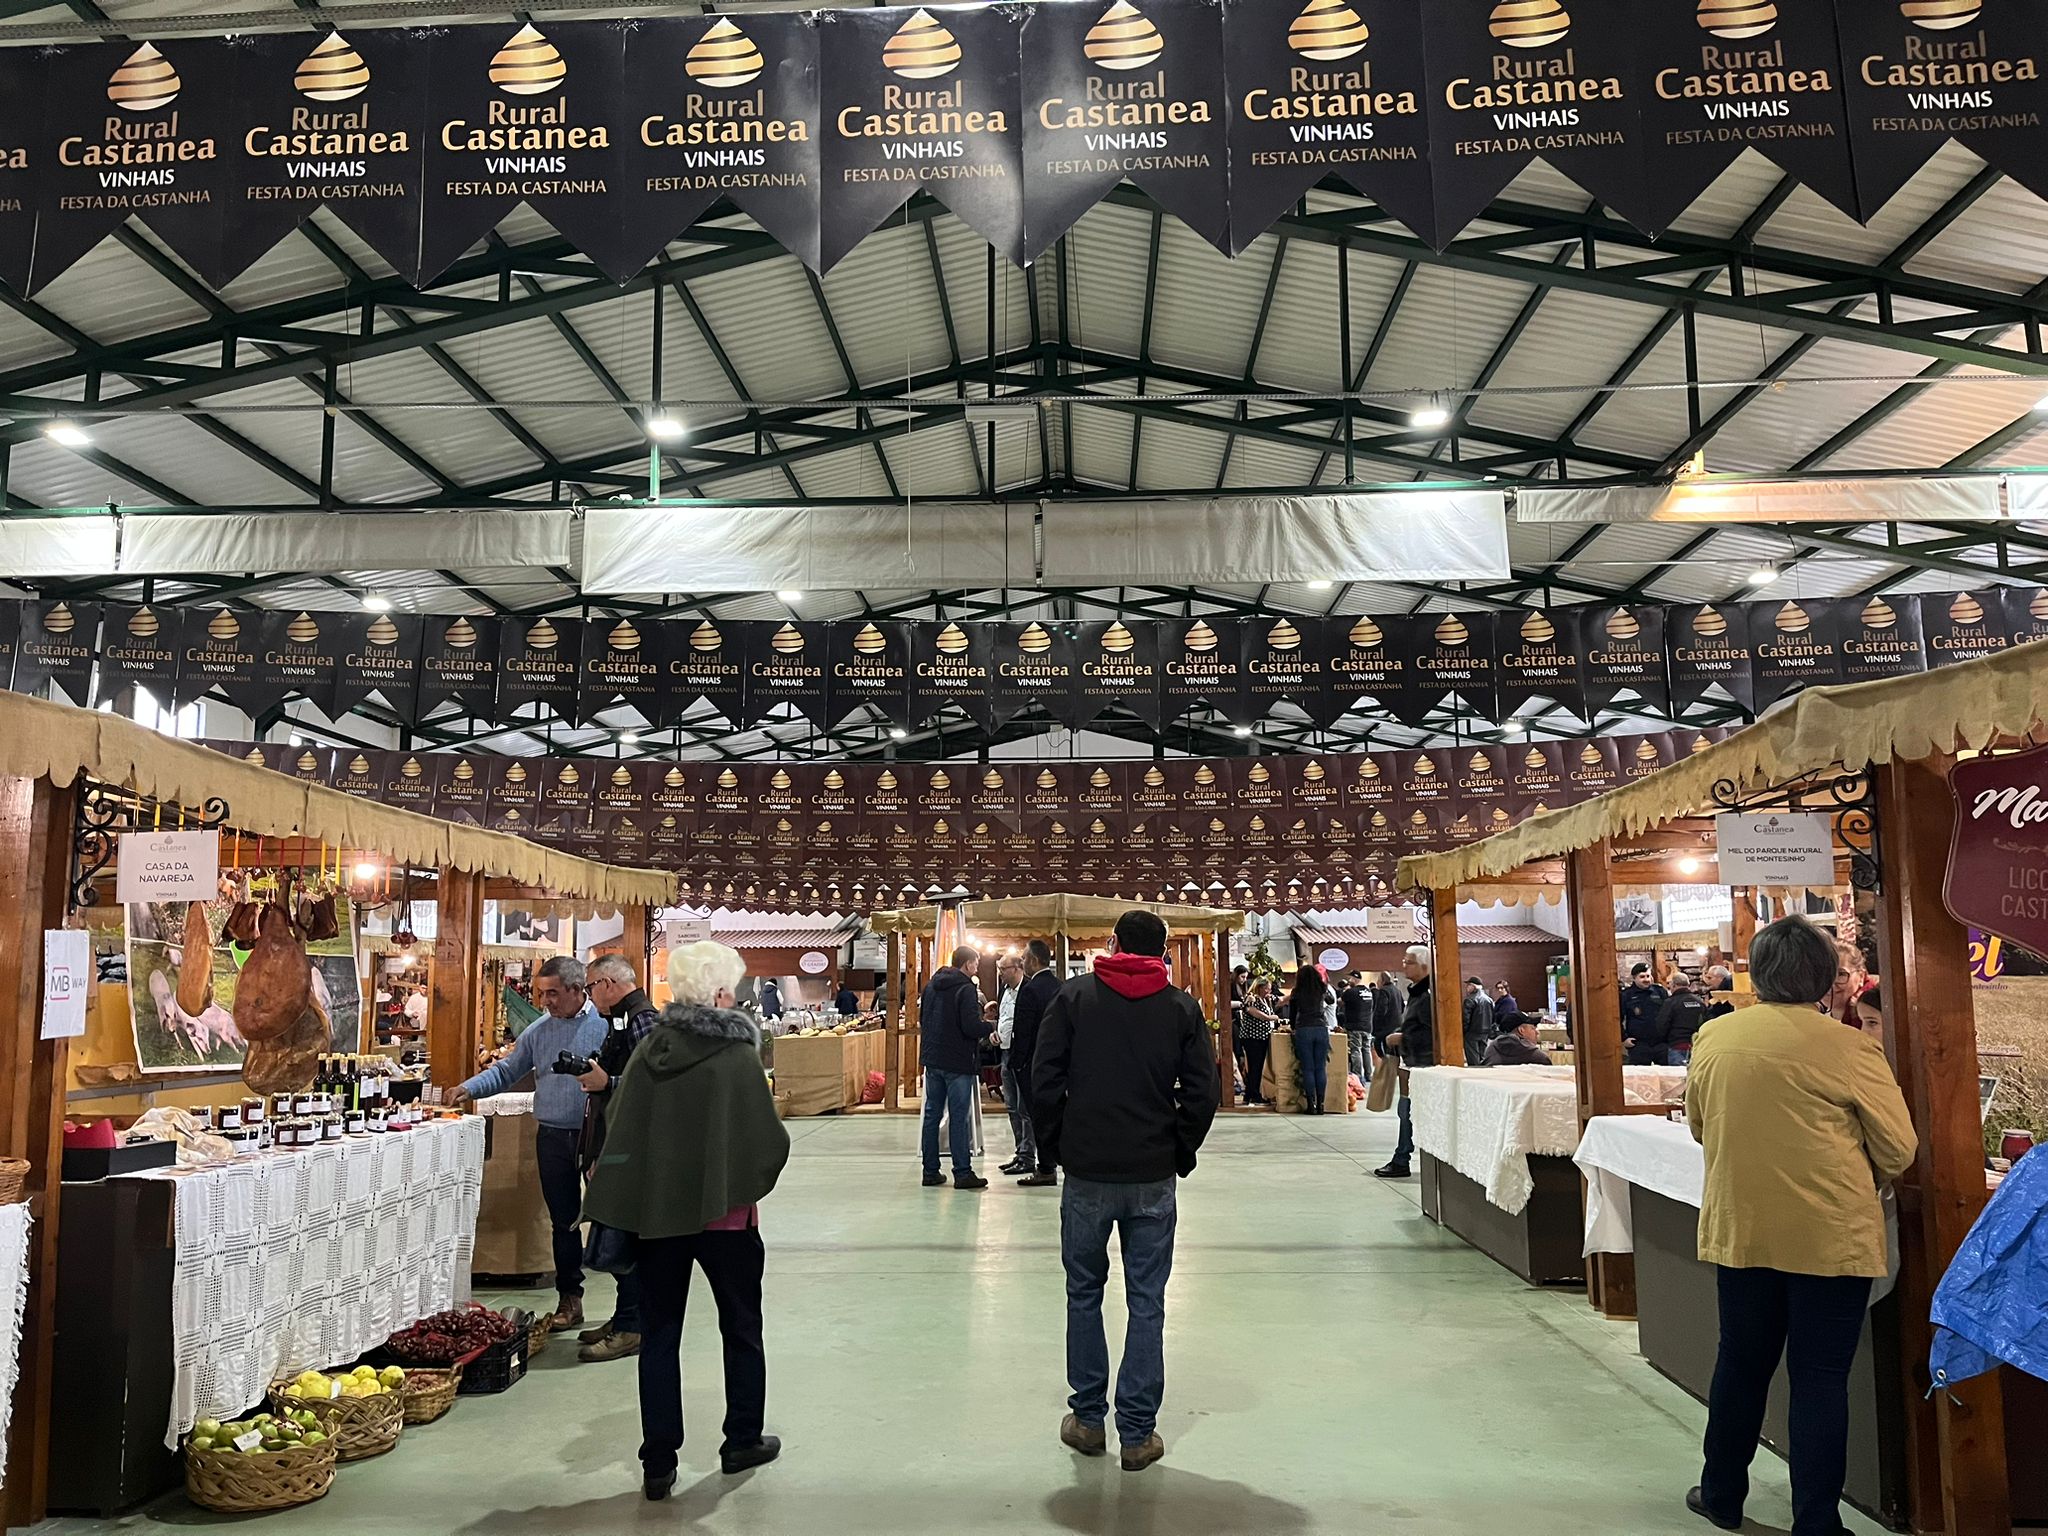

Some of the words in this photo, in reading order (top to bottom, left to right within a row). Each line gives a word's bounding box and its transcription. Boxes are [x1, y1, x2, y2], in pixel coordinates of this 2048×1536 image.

[1906, 31, 1985, 60] Rural
[1703, 40, 1782, 69] Rural
[1493, 49, 1574, 80] Rural
[1862, 56, 2038, 85] Castanea
[1291, 62, 1370, 91] Rural
[1085, 71, 1165, 100] Rural
[1656, 69, 1832, 99] Castanea
[885, 80, 962, 109] Rural
[1446, 78, 1623, 109] Castanea
[1908, 91, 1992, 109] VINHAIS
[489, 97, 565, 124] Rural
[687, 89, 763, 118] Rural
[1244, 90, 1418, 120] Castanea
[1704, 100, 1789, 120] VINHAIS
[292, 103, 368, 130] Rural
[1039, 99, 1211, 129] Castanea
[1493, 109, 1579, 130] VINHAIS
[105, 111, 177, 140] Rural
[837, 106, 1008, 137] Castanea
[1873, 118, 1919, 130] FESTA
[1924, 116, 1947, 131] DA
[1948, 113, 2039, 130] CASTANHA
[442, 121, 609, 150] Castanea
[641, 115, 809, 147] Castanea
[1290, 123, 1373, 142] VINHAIS
[1667, 130, 1714, 144] FESTA
[1718, 128, 1742, 141] DA
[1746, 123, 1834, 139] CASTANHA
[246, 127, 409, 155] Castanea
[1084, 132, 1167, 151] VINHAIS
[1456, 140, 1503, 155] FESTA
[1507, 138, 1531, 151] DA
[1535, 132, 1624, 149] CASTANHA
[59, 137, 216, 165] Castanea
[882, 141, 963, 159] VINHAIS
[1252, 151, 1298, 165] FESTA
[1303, 150, 1325, 163] DA
[1329, 147, 1416, 162] CASTANHA
[485, 157, 566, 173] VINHAIS
[684, 149, 765, 168] VINHAIS
[1047, 160, 1092, 174] FESTA
[1096, 158, 1119, 172] DA
[1123, 155, 1209, 170] CASTANHA
[287, 161, 365, 178] VINHAIS
[845, 168, 890, 182] FESTA
[894, 168, 916, 180] DA
[919, 164, 1005, 181] CASTANHA
[99, 169, 174, 187] VINHAIS
[647, 177, 691, 191] FESTA
[695, 176, 717, 188] DA
[721, 173, 807, 187] CASTANHA
[248, 187, 291, 199] FESTA
[296, 186, 317, 198] DA
[322, 184, 404, 198] CASTANHA
[447, 182, 492, 195] FESTA
[496, 182, 518, 194] DA
[522, 180, 606, 194] CASTANHA
[61, 196, 103, 209] FESTA
[107, 193, 129, 209] DA
[132, 190, 210, 207] CASTANHA
[24, 641, 88, 656] Castanea
[1844, 640, 1919, 653] Castanea
[1933, 636, 2006, 649] Castanea
[107, 645, 172, 660] Castanea
[187, 648, 253, 663] Castanea
[1589, 650, 1660, 663] Castanea
[1676, 648, 1749, 661] Castanea
[1758, 644, 1833, 657] Castanea
[39, 657, 69, 665] VINHAIS
[122, 661, 154, 669] VINHAIS
[266, 651, 333, 666] Castanea
[346, 654, 412, 669] Castanea
[425, 657, 492, 671] Castanea
[507, 658, 573, 672] Castanea
[1331, 658, 1402, 671] Castanea
[1417, 656, 1488, 669] Castanea
[1503, 654, 1576, 667] Castanea
[1778, 658, 1815, 666] VINHAIS
[1864, 654, 1901, 663] VINHAIS
[203, 664, 235, 672] VINHAIS
[282, 667, 315, 675] VINHAIS
[588, 659, 657, 673] Castanea
[671, 661, 738, 674] Castanea
[753, 663, 821, 676] Castanea
[835, 663, 903, 676] Castanea
[917, 663, 986, 676] Castanea
[1000, 663, 1068, 676] Castanea
[1083, 662, 1152, 675] Castanea
[1166, 662, 1236, 674] Castanea
[1249, 660, 1320, 673] Castanea
[1522, 668, 1558, 676] VINHAIS
[1608, 665, 1643, 673] VINHAIS
[1696, 662, 1731, 670] VINHAIS
[362, 670, 394, 678] VINHAIS
[523, 674, 555, 682] VINHAIS
[605, 675, 639, 683] VINHAIS
[1268, 675, 1302, 683] VINHAIS
[1435, 671, 1471, 679] VINHAIS
[1017, 678, 1051, 686] VINHAIS
[1571, 771, 1615, 780] Castanea
[389, 782, 430, 792] Castanea
[1348, 785, 1392, 793] Castanea
[1459, 779, 1504, 787] Castanea
[494, 787, 535, 797] Castanea
[598, 792, 642, 802] Castanea
[652, 793, 695, 802] Castanea
[706, 794, 748, 803] Castanea
[759, 795, 801, 803] Castanea
[972, 795, 1014, 803] Castanea
[1026, 795, 1068, 803] Castanea
[1133, 792, 1176, 801] Castanea
[1183, 791, 1227, 799] Castanea
[1238, 789, 1281, 798] Castanea
[812, 795, 854, 804] Castanea
[145, 863, 173, 871] CASA
[175, 862, 189, 870] DA
[139, 874, 195, 883] NAVAREJA
[50, 975, 70, 992] MB
[72, 976, 86, 989] WAY
